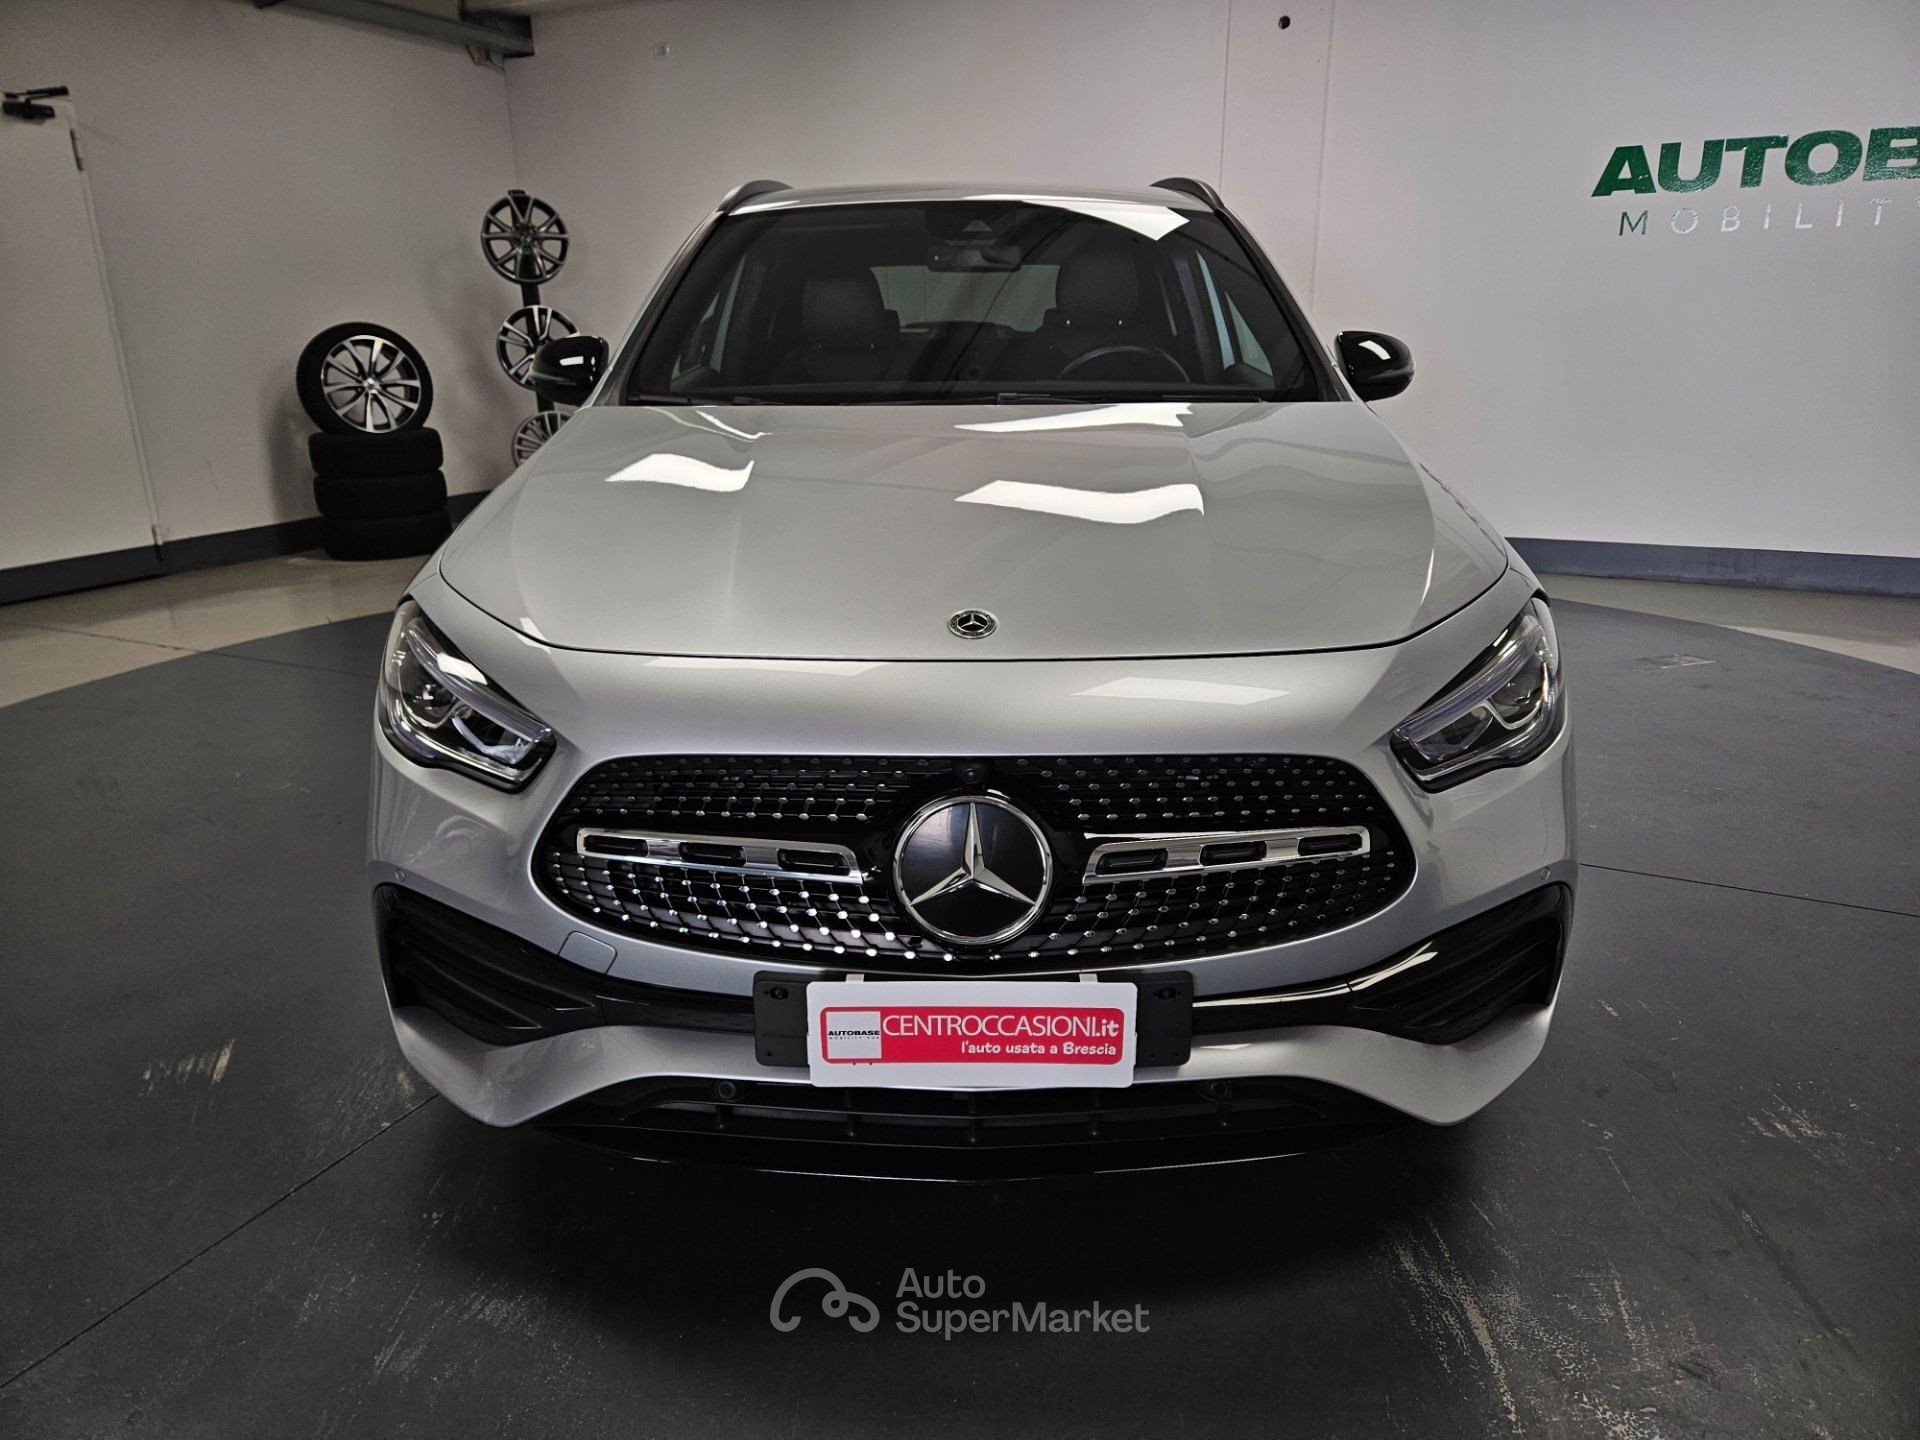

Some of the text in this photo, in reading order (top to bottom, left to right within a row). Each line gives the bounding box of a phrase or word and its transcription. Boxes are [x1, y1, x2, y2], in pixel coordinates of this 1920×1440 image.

[1619, 196, 1920, 236] MOBILIT
[882, 1014, 1119, 1037] CENTROCCASIONI.it
[961, 1041, 1117, 1055] l'auto usata a Brescia
